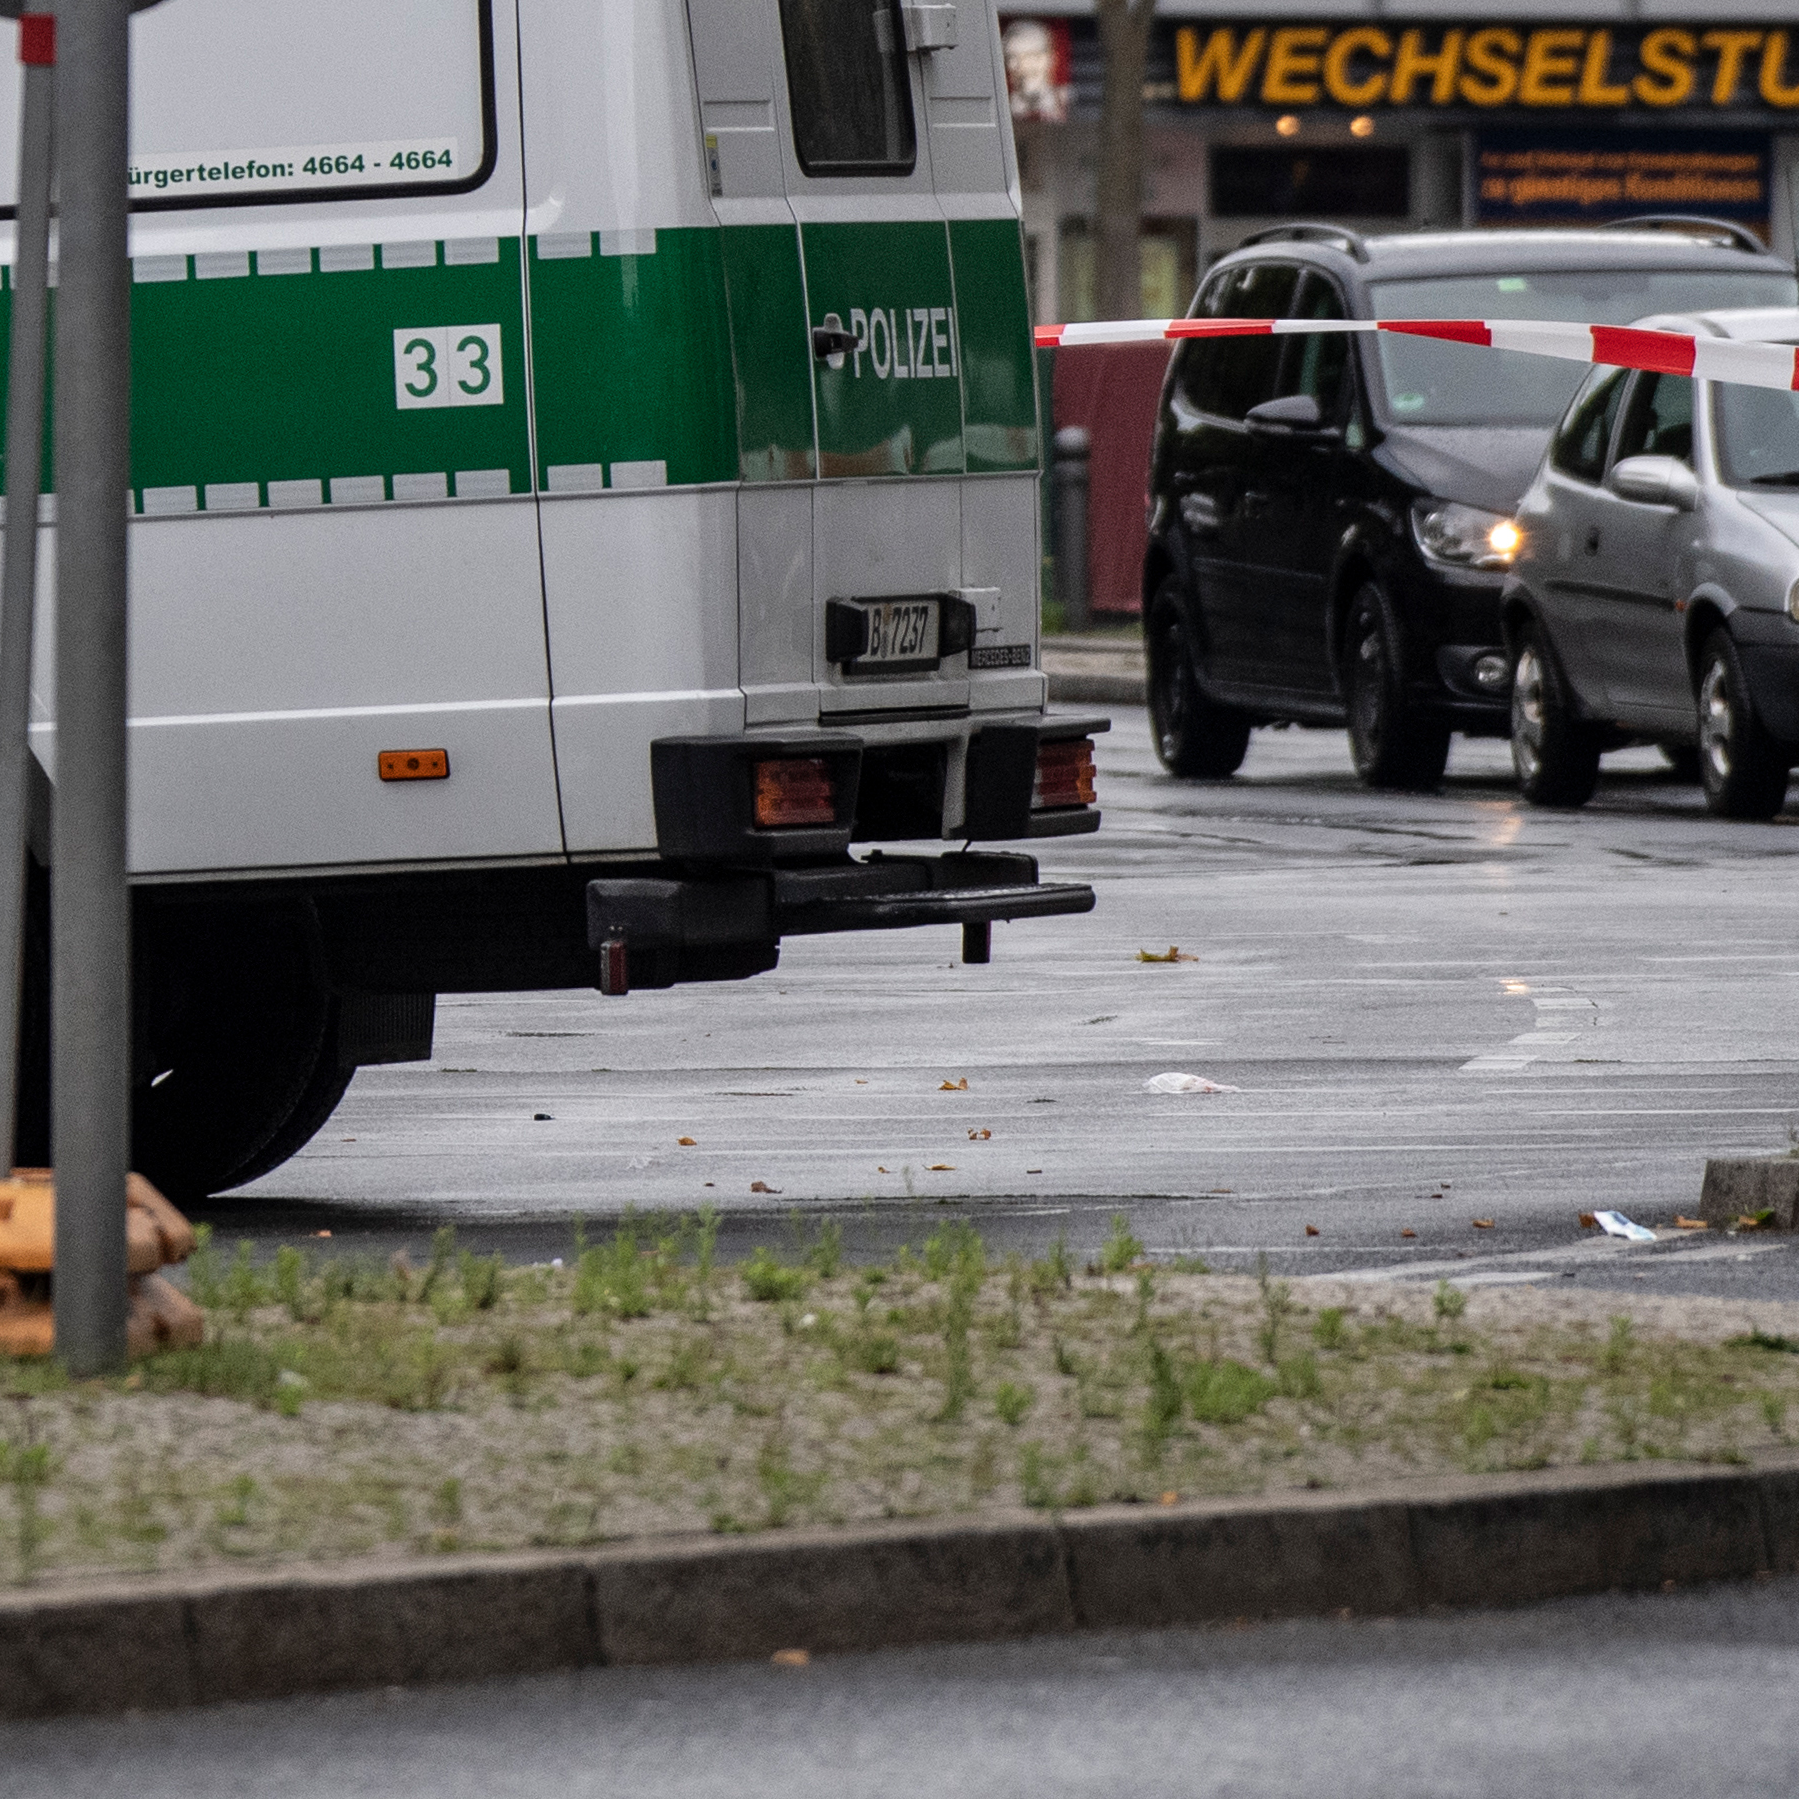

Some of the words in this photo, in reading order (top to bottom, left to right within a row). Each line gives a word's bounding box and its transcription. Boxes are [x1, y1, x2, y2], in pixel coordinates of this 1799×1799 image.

[127, 159, 296, 191] ürgertelefon:
[302, 153, 366, 178] 4664
[389, 147, 453, 172] 4664
[403, 335, 492, 398] 33
[850, 306, 959, 380] POLIZEI
[888, 604, 929, 656] 7237
